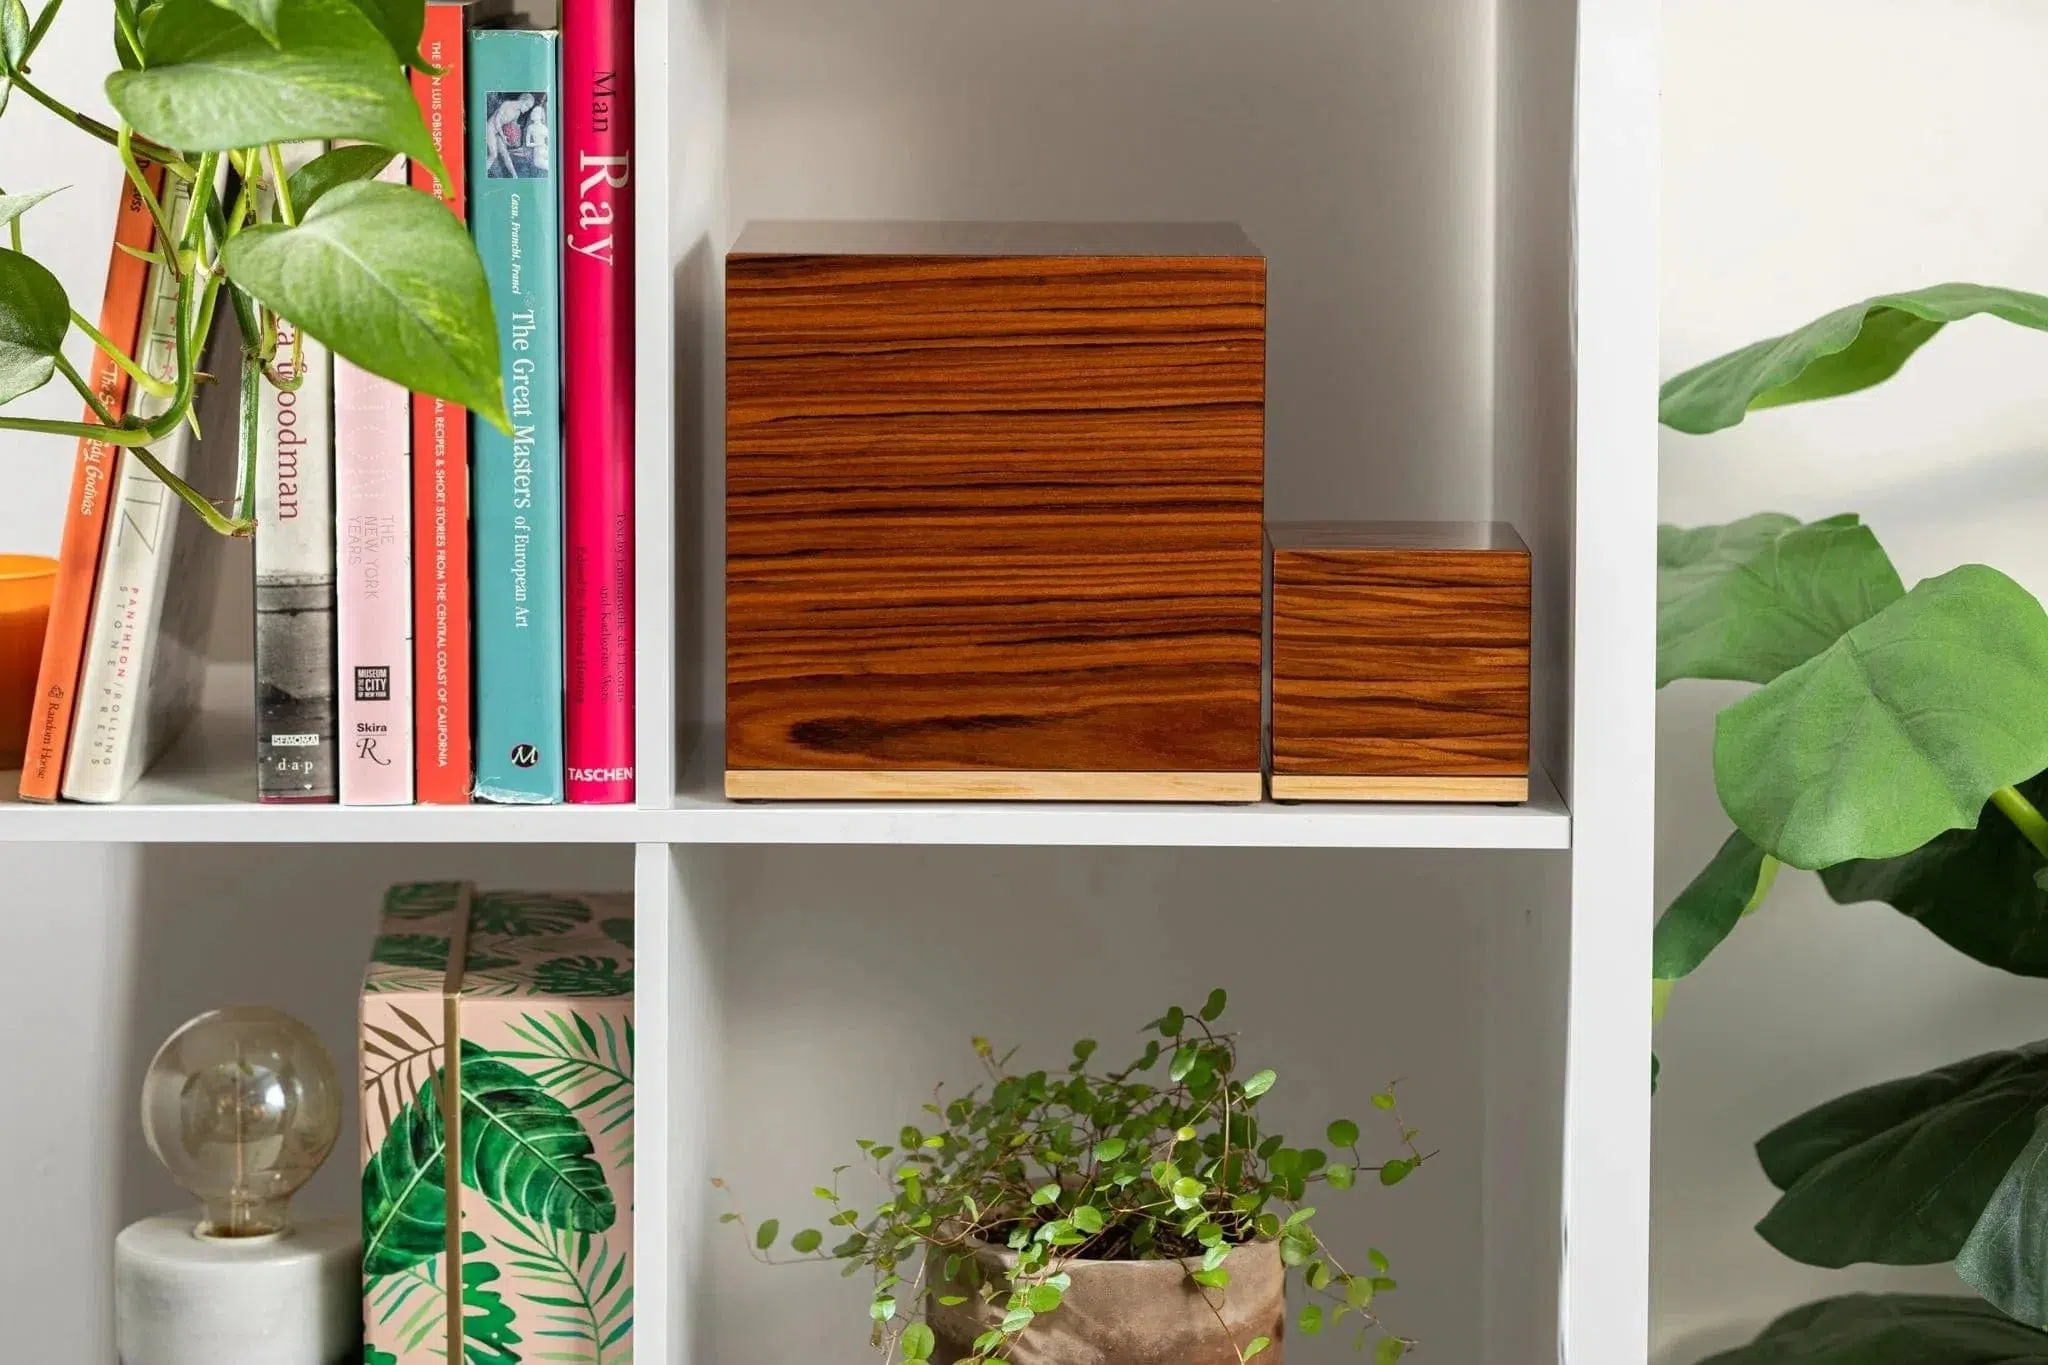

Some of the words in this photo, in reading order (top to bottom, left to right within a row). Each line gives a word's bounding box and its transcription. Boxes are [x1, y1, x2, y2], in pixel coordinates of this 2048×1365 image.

[432, 41, 441, 60] THE
[432, 63, 442, 85] SN
[432, 88, 442, 110] LUIS
[592, 69, 616, 133] Man
[510, 193, 520, 219] Casu,
[567, 150, 629, 266] Ray
[512, 309, 536, 351] The
[101, 360, 118, 389] The
[512, 358, 535, 417] Great
[435, 417, 445, 456] RECIPES
[513, 424, 536, 509] Masters
[81, 465, 103, 516] Godivas
[435, 470, 446, 503] SHORT
[364, 516, 378, 553] NEW
[380, 514, 395, 545] THE
[435, 507, 446, 547] STORIES
[514, 515, 531, 531] of
[348, 515, 362, 566] YEARS
[364, 558, 380, 601] YORK
[436, 550, 446, 580] FROM
[511, 534, 529, 602] European
[437, 583, 447, 601] THE
[107, 586, 128, 667] STONE
[436, 604, 447, 649] CENTRAL
[515, 606, 530, 628] Art
[617, 635, 628, 649] de
[358, 669, 387, 678] MUSEUM
[365, 679, 387, 691] CITY
[437, 652, 447, 685] COAST
[437, 687, 447, 702] OF
[42, 702, 60, 745] Random
[91, 688, 111, 765] PRESS
[356, 723, 387, 733] Skira
[437, 705, 448, 767] CALIFORNIA
[37, 748, 54, 778] House
[568, 767, 633, 782] TASCHEN
